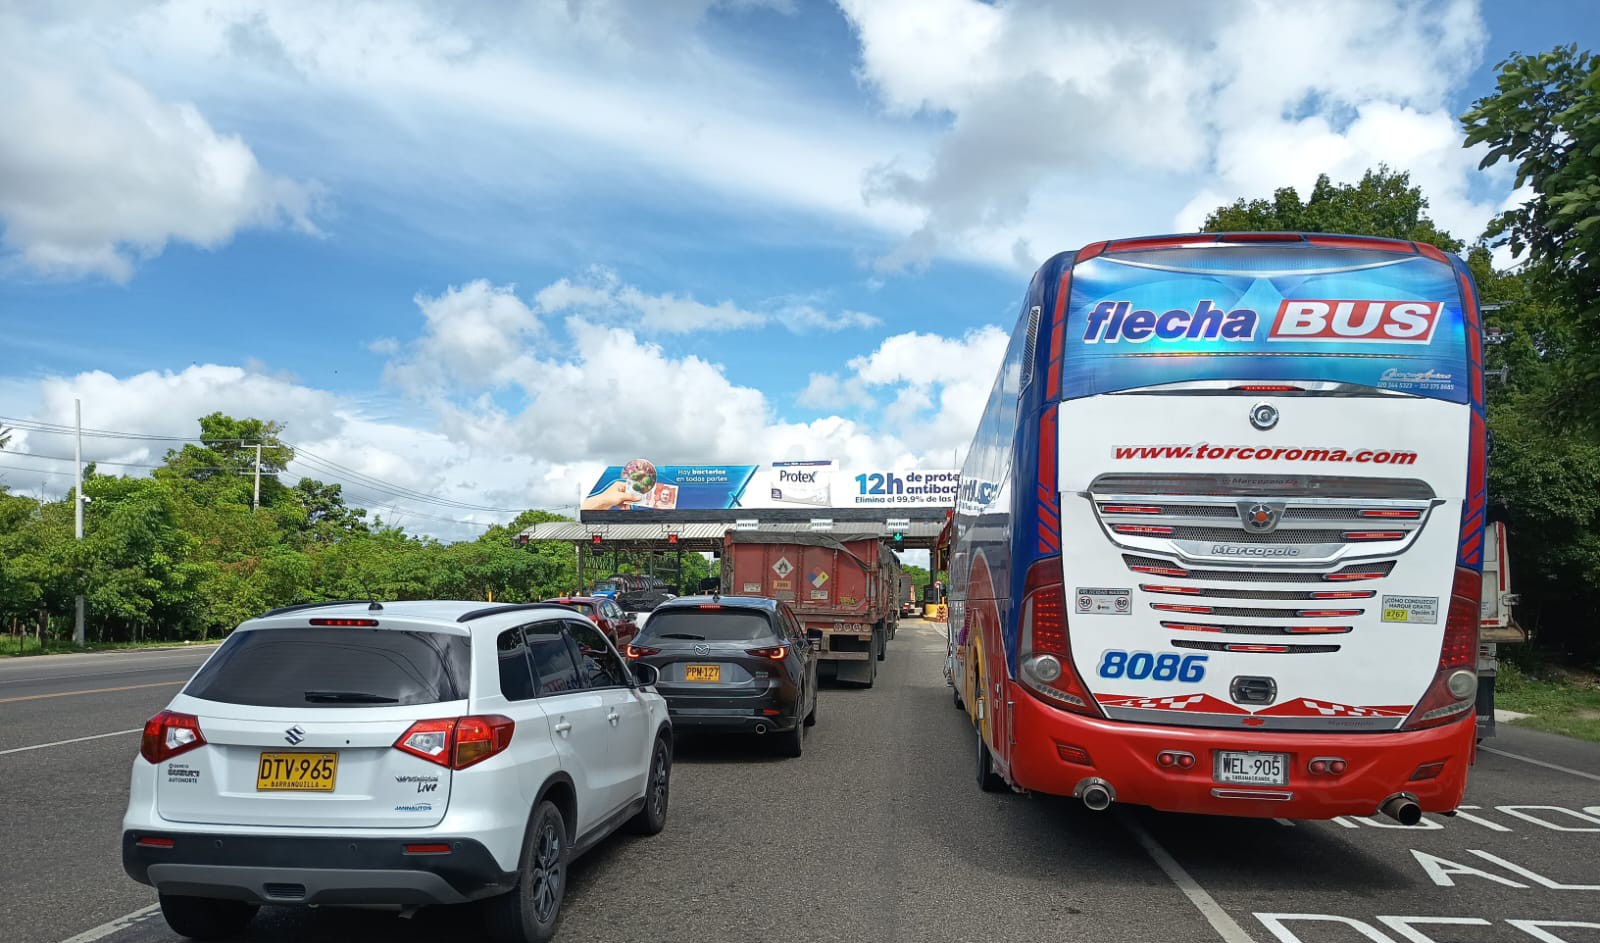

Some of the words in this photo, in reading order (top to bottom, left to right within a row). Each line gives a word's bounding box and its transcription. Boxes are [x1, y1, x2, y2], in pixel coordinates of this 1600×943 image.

[1083, 300, 1258, 343] flecha
[1275, 300, 1432, 339] BUS
[1112, 442, 1418, 465] www.torcoroma.com
[706, 476, 728, 484] partes
[779, 470, 816, 483] Protex
[906, 472, 923, 482] de
[854, 472, 904, 495] 12h
[1211, 545, 1300, 557] Marcopolo
[1096, 649, 1208, 683] 8086
[417, 781, 438, 793] Live
